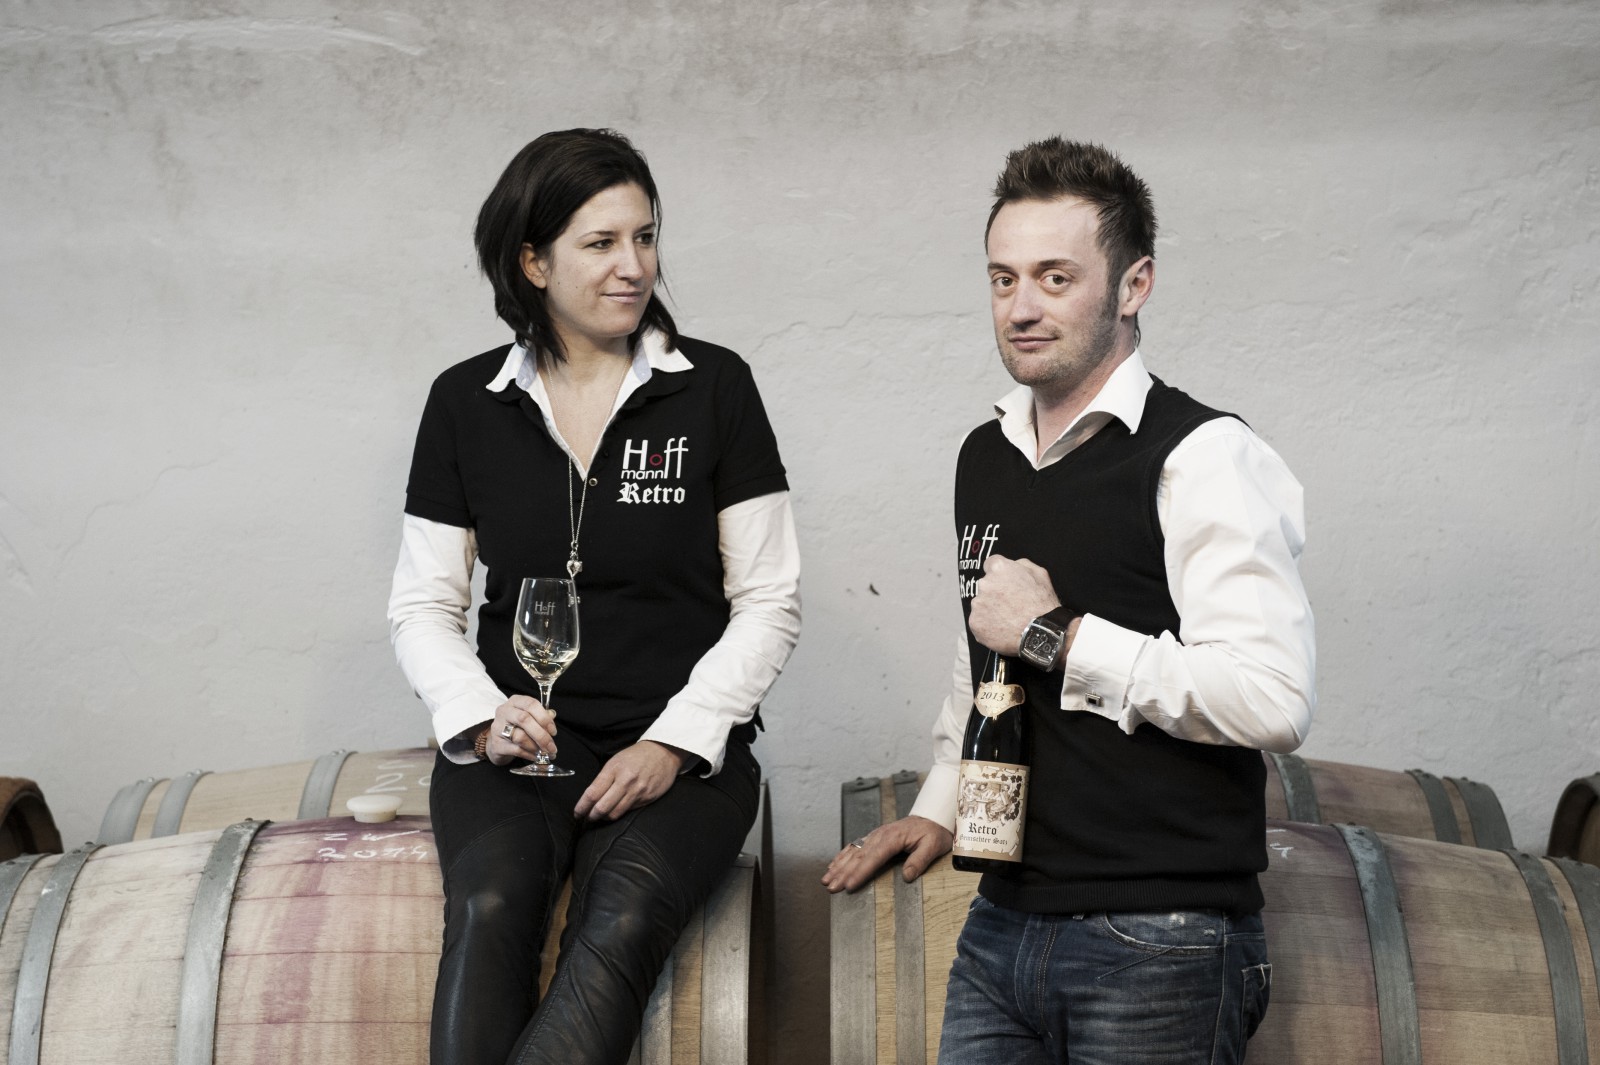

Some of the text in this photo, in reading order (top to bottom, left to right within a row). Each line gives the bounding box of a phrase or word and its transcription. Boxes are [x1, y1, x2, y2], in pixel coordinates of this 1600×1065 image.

[622, 436, 689, 479] Hoff
[620, 469, 664, 480] mann
[616, 481, 686, 504] Retro
[980, 691, 1005, 702] 2013
[968, 821, 997, 836] Retro
